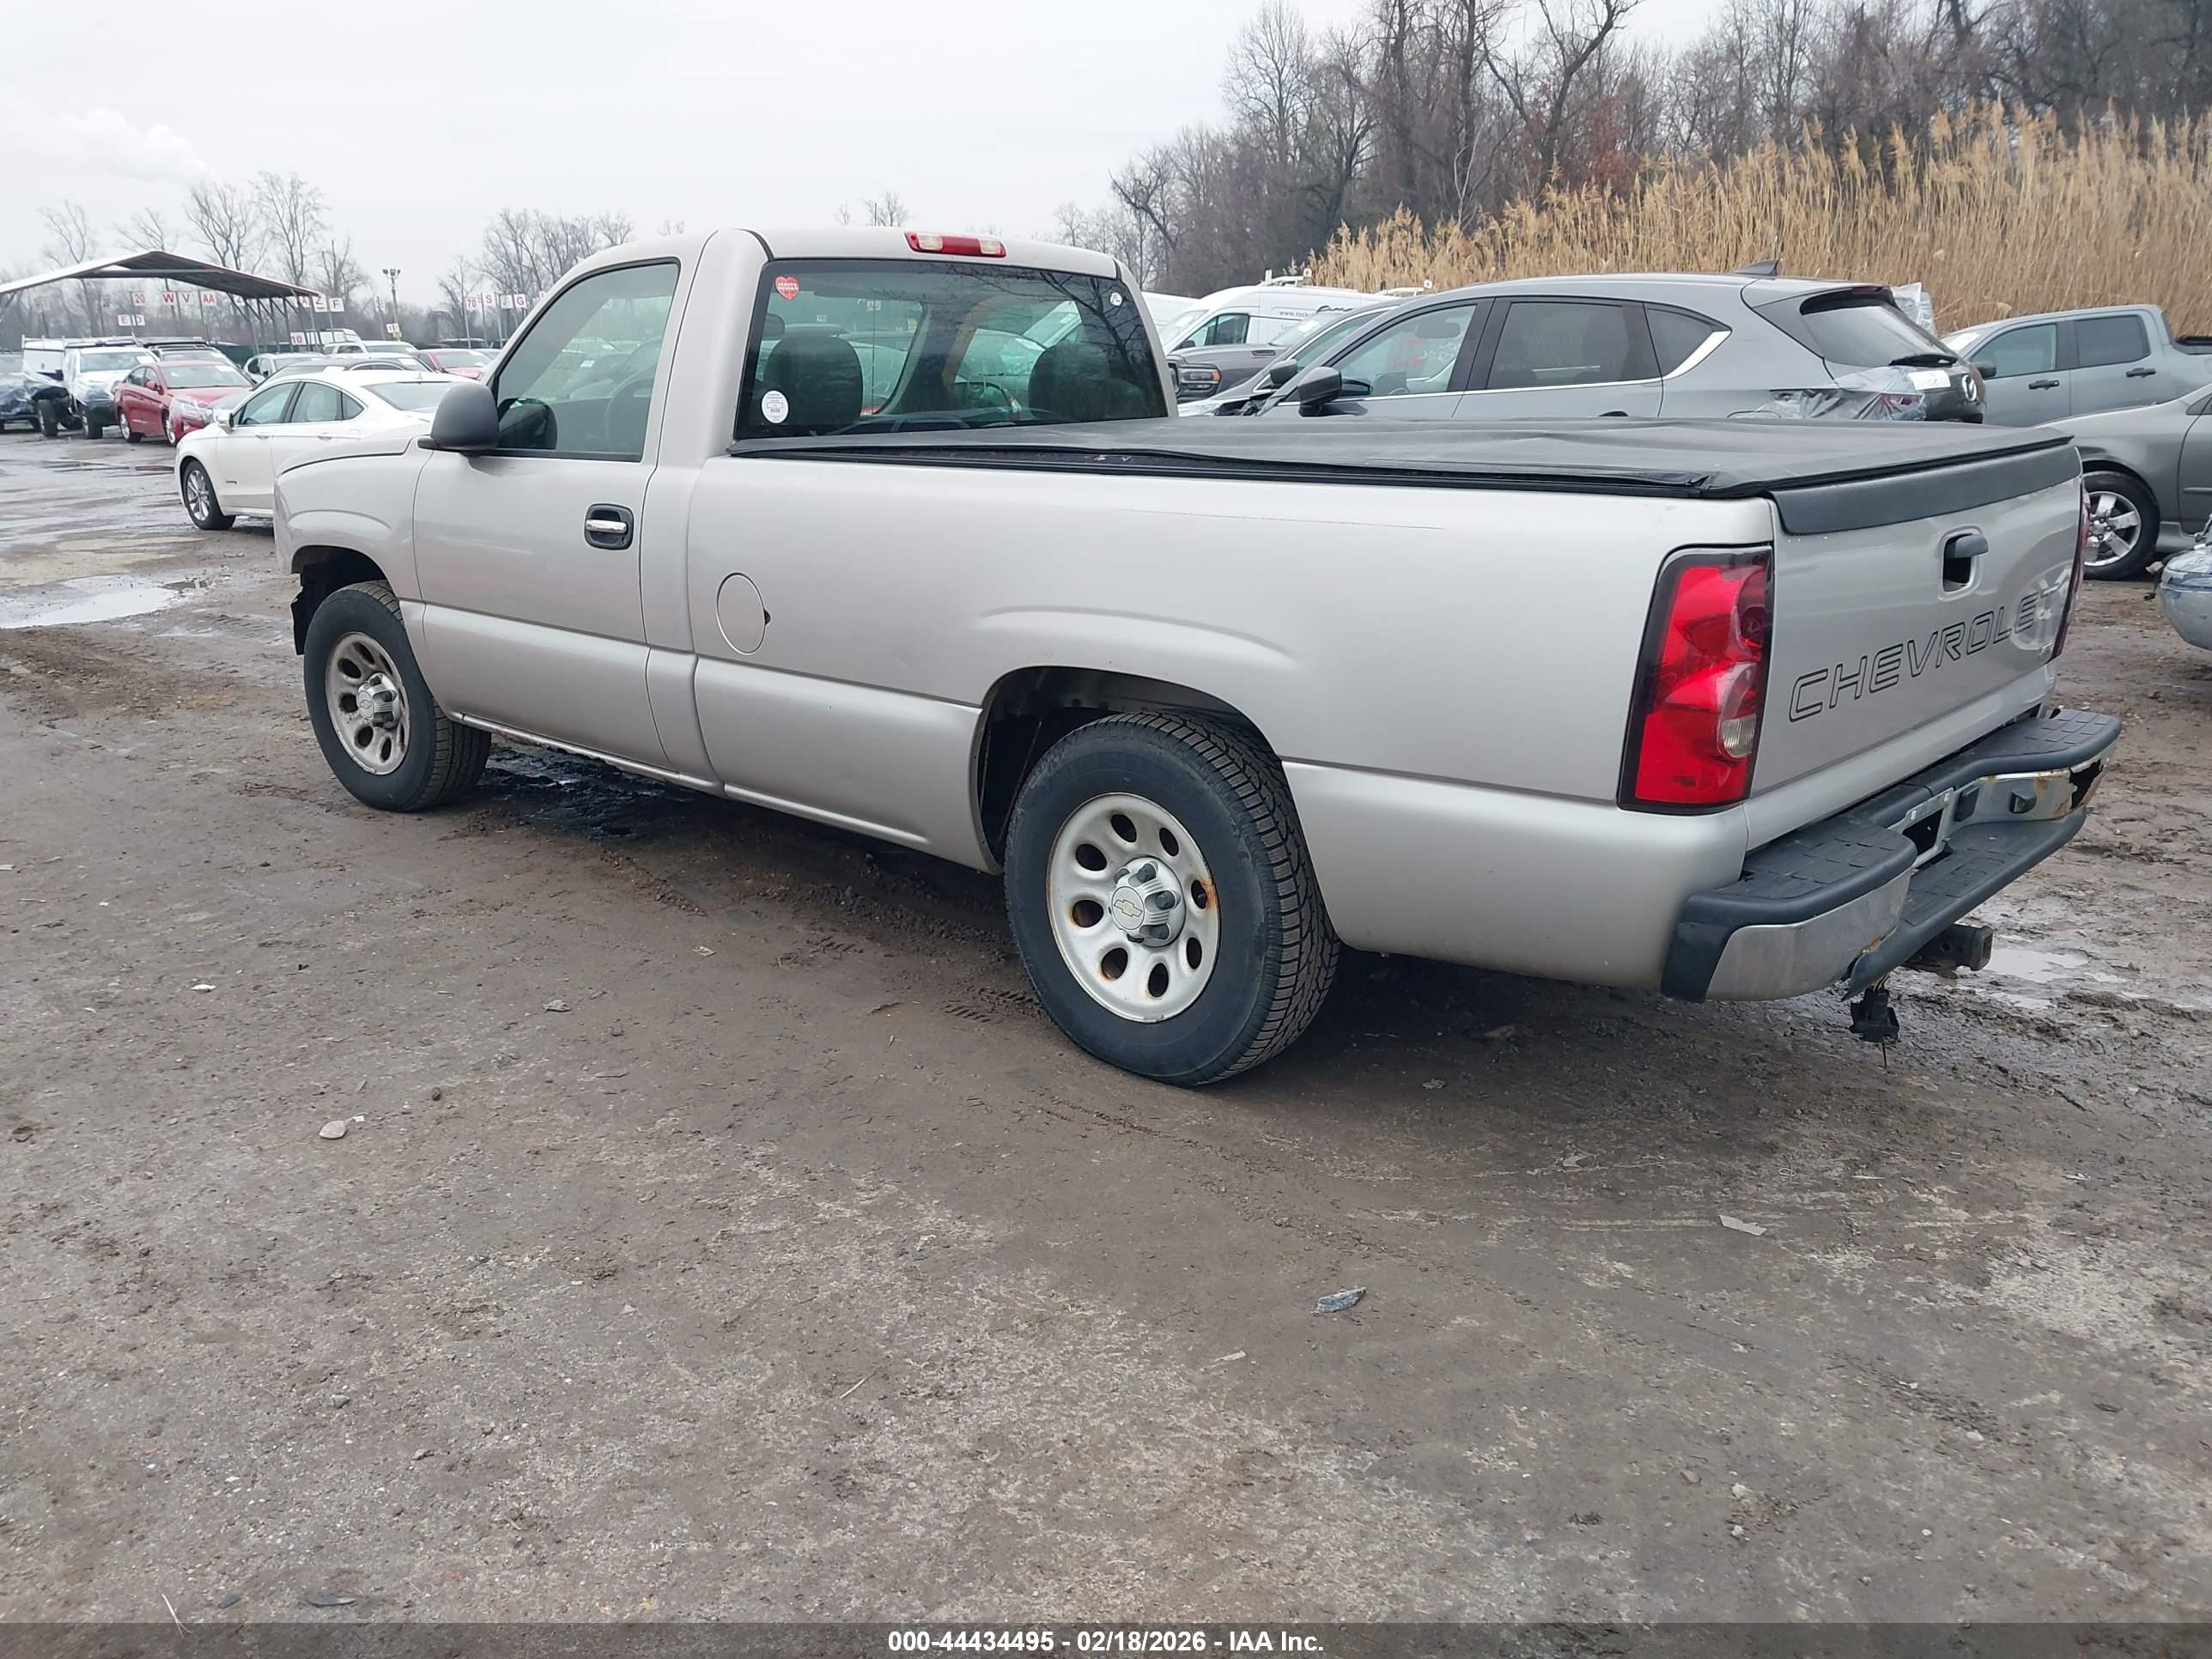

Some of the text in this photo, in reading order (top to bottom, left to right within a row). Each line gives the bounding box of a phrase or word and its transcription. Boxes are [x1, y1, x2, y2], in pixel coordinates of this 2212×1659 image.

[134, 294, 145, 303] 20
[163, 294, 174, 303] W
[181, 294, 190, 302] V
[203, 295, 215, 303] AA
[485, 295, 492, 303] S
[517, 296, 524, 305] G
[467, 299, 477, 308] 70
[291, 335, 301, 343] 10
[1788, 585, 2061, 723] CHEVROLET
